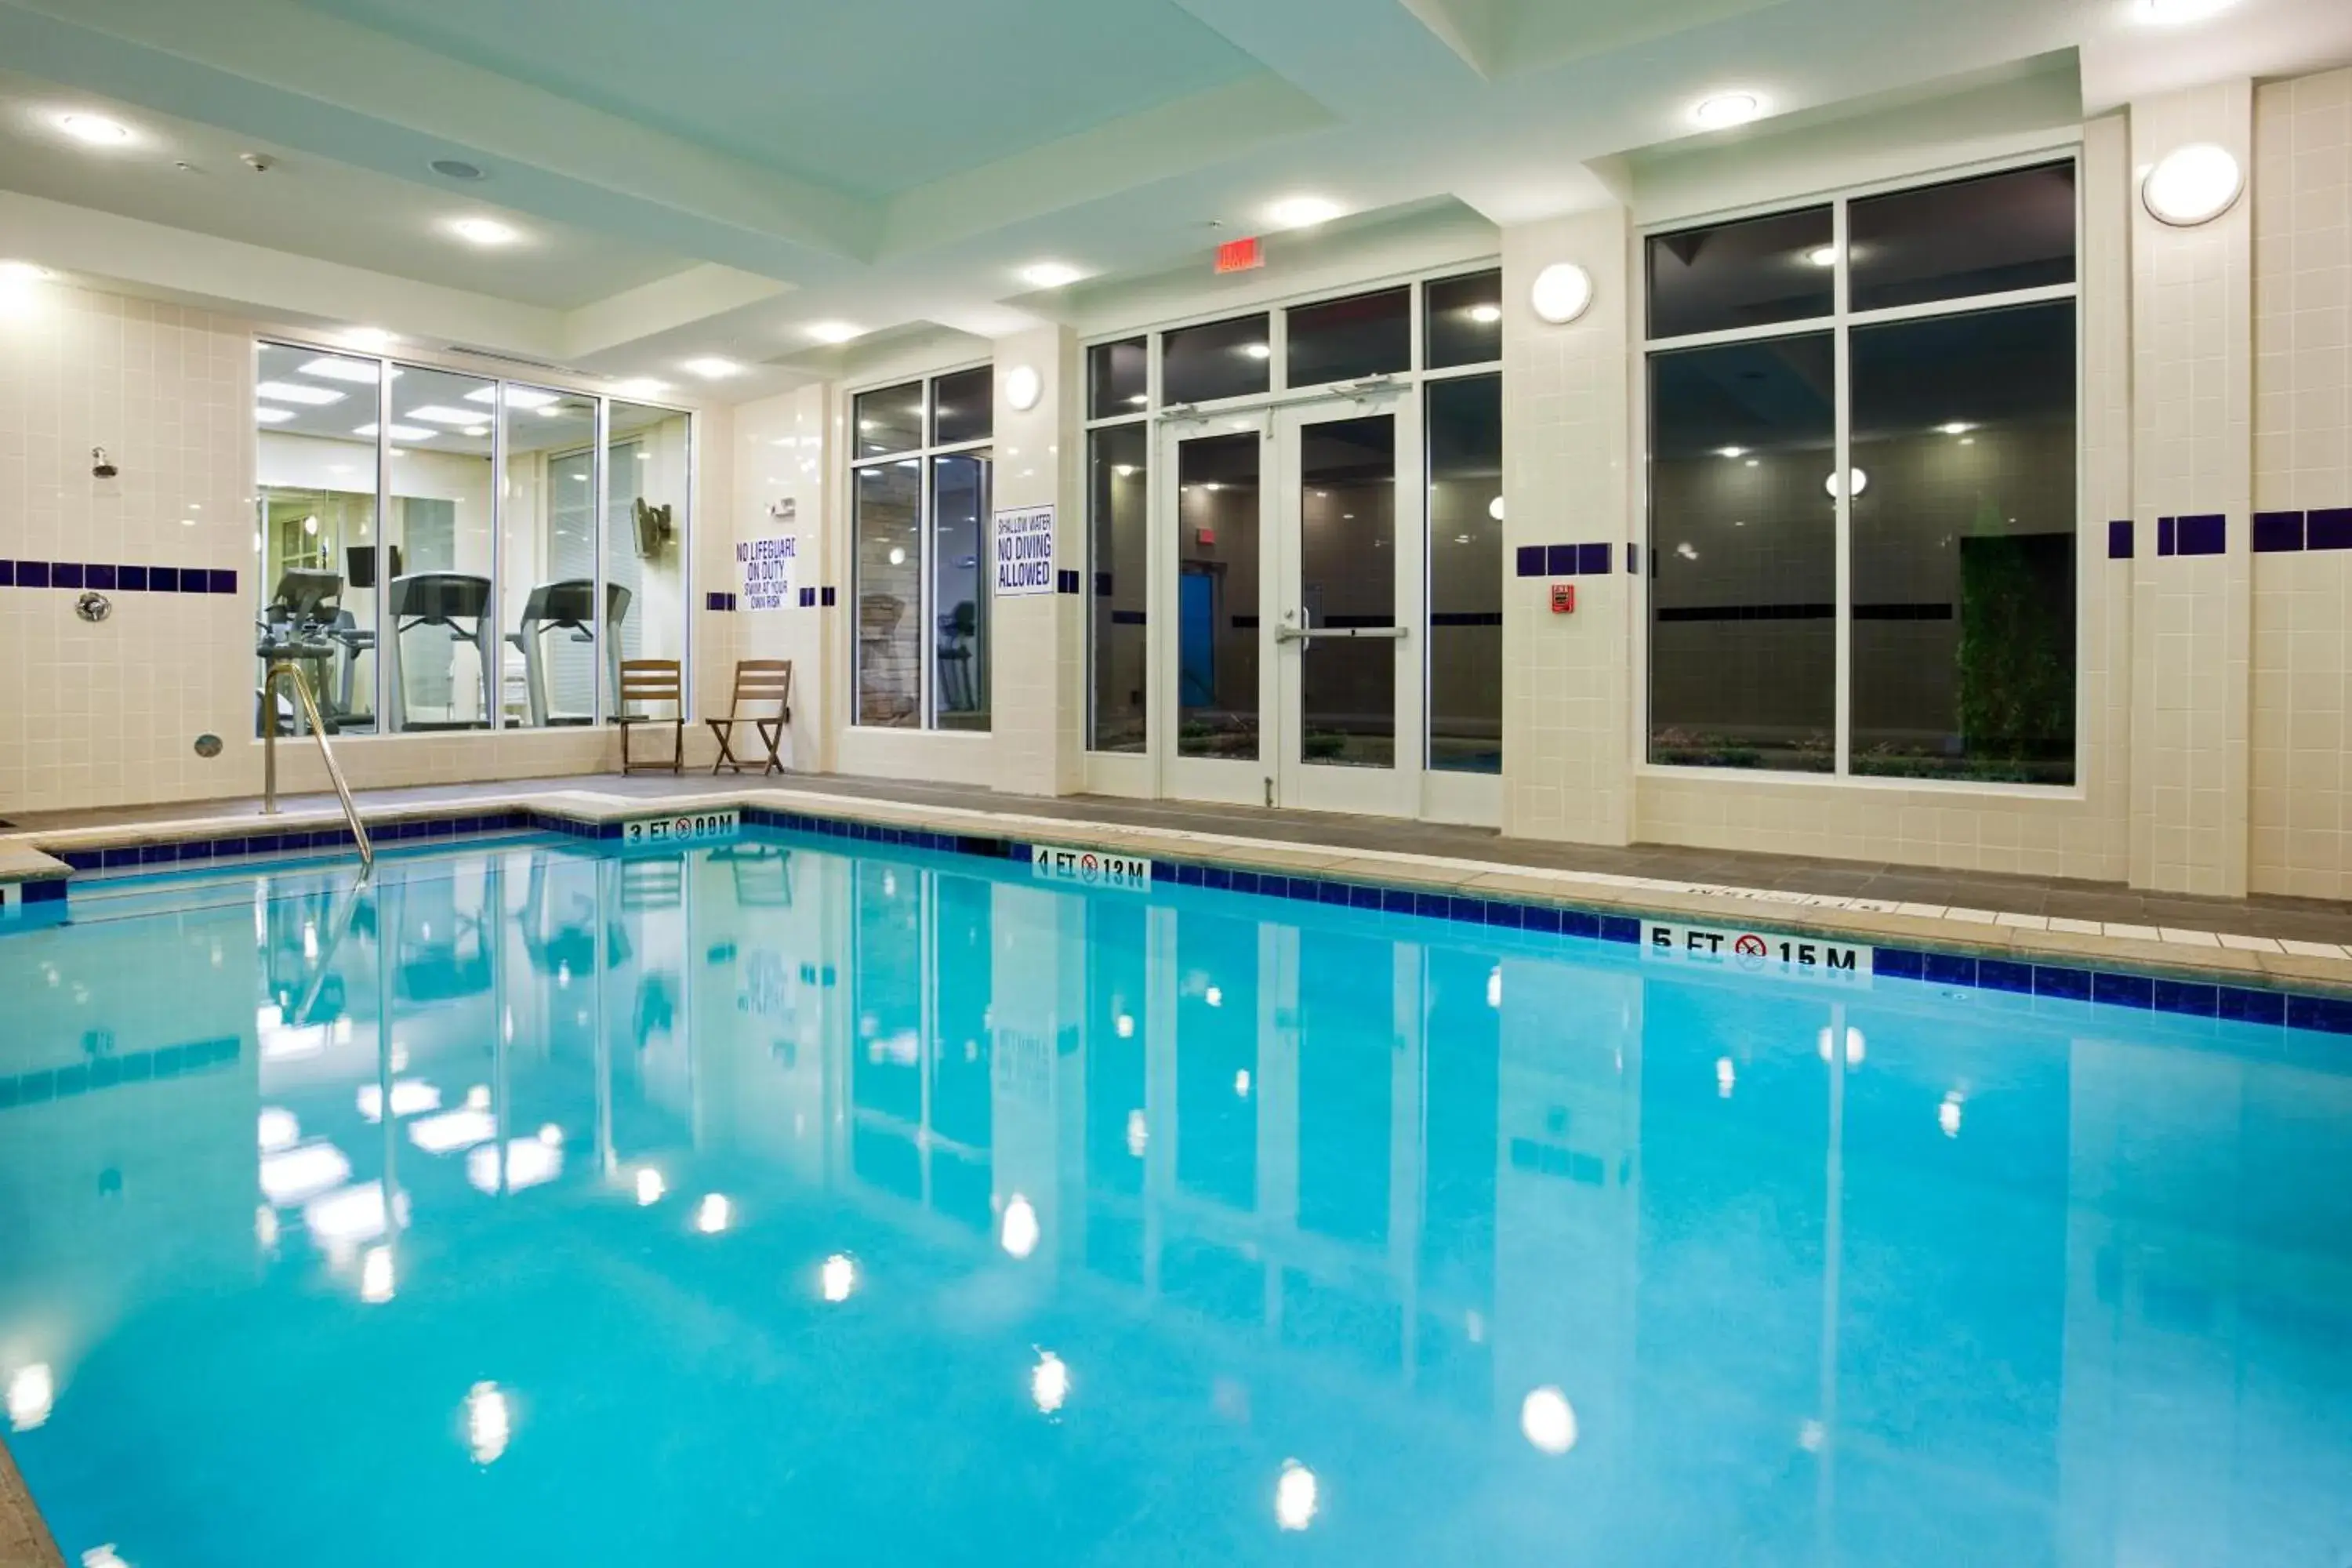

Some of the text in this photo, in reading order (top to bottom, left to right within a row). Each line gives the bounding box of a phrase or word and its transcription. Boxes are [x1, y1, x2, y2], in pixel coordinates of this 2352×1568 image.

[998, 514, 1051, 534] SHALLOW WATER
[736, 542, 749, 561] NO
[998, 533, 1051, 561] NO DIVING
[747, 559, 785, 581] ON DUTY
[998, 561, 1050, 587] ALLOWED
[1057, 852, 1076, 869] FT
[1652, 927, 1671, 947] 5
[1687, 931, 1724, 953] FT
